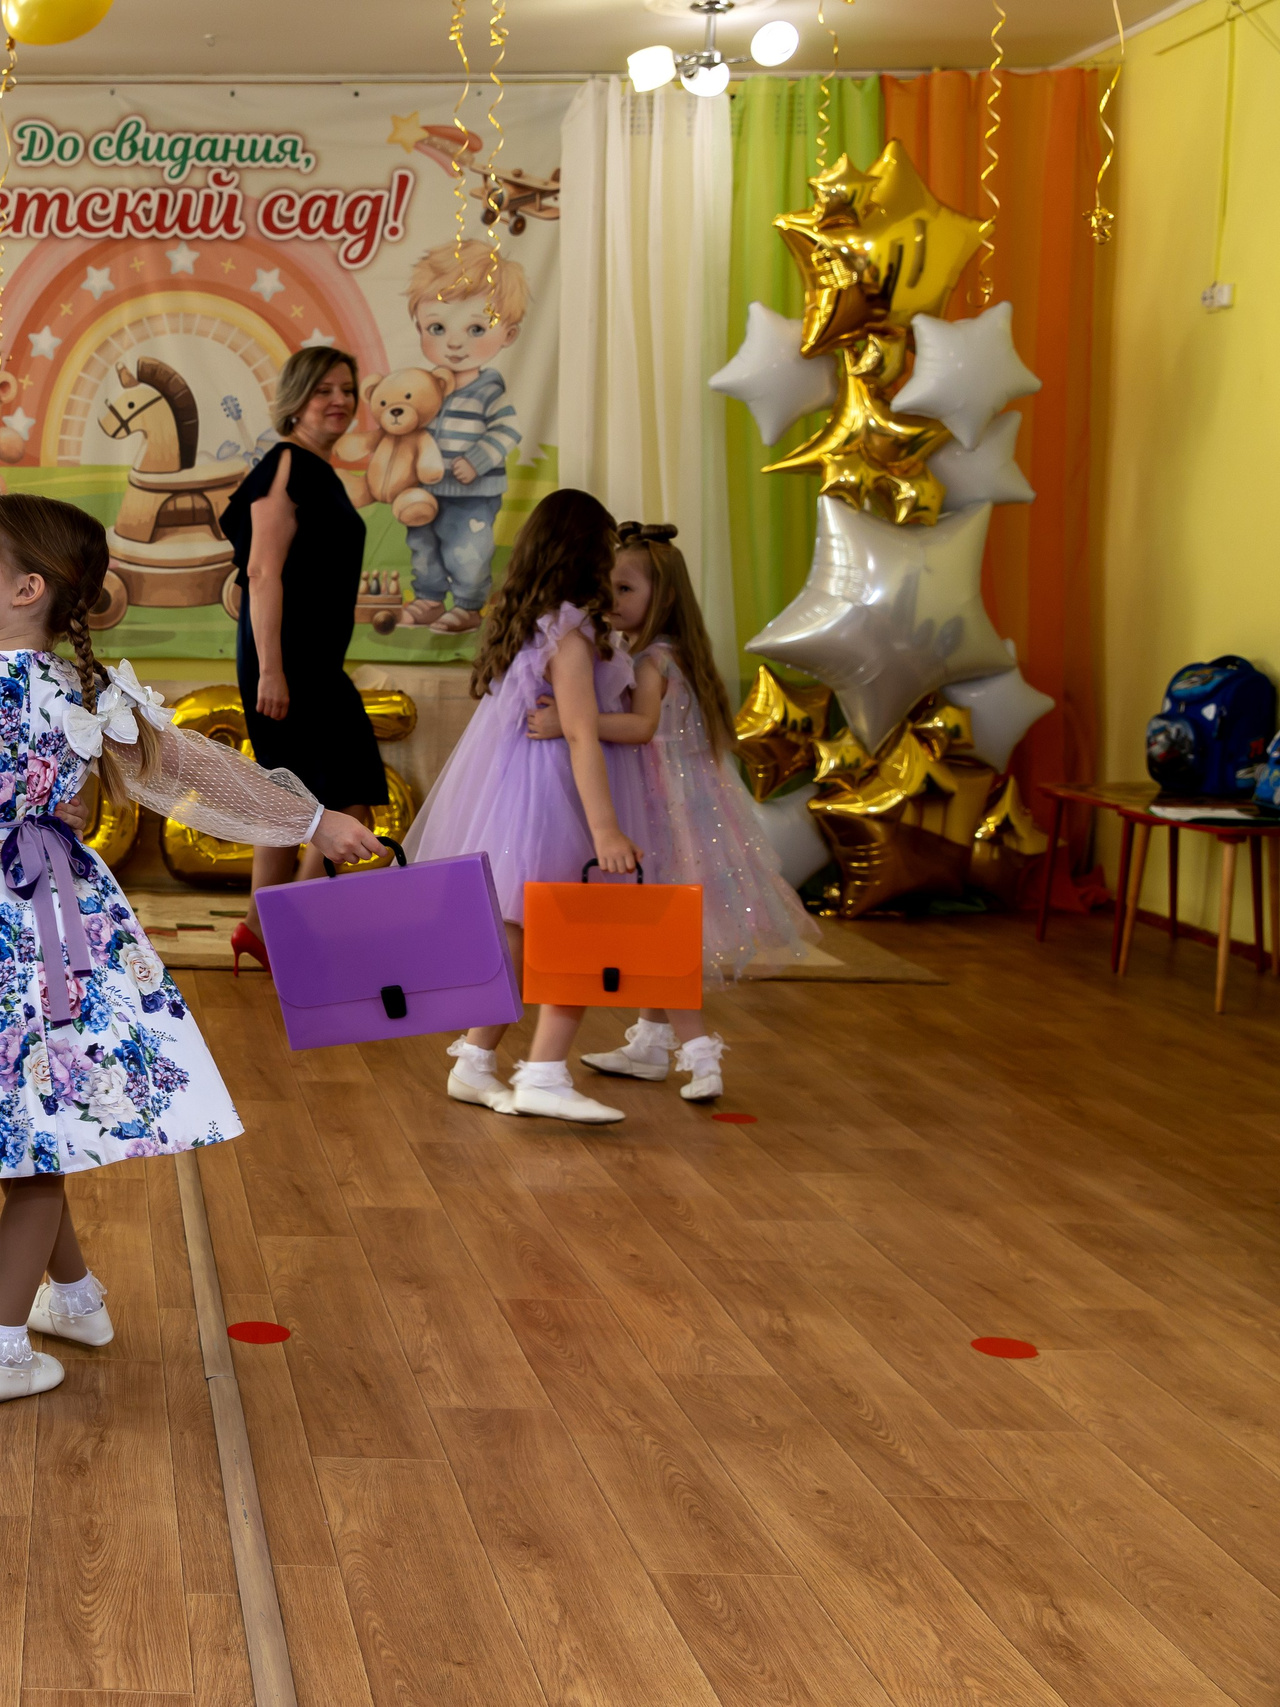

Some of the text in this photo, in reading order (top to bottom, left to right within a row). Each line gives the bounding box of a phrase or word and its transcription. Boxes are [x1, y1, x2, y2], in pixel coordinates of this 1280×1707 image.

[18, 121, 313, 178] До свидания,
[261, 173, 413, 265] сад!
